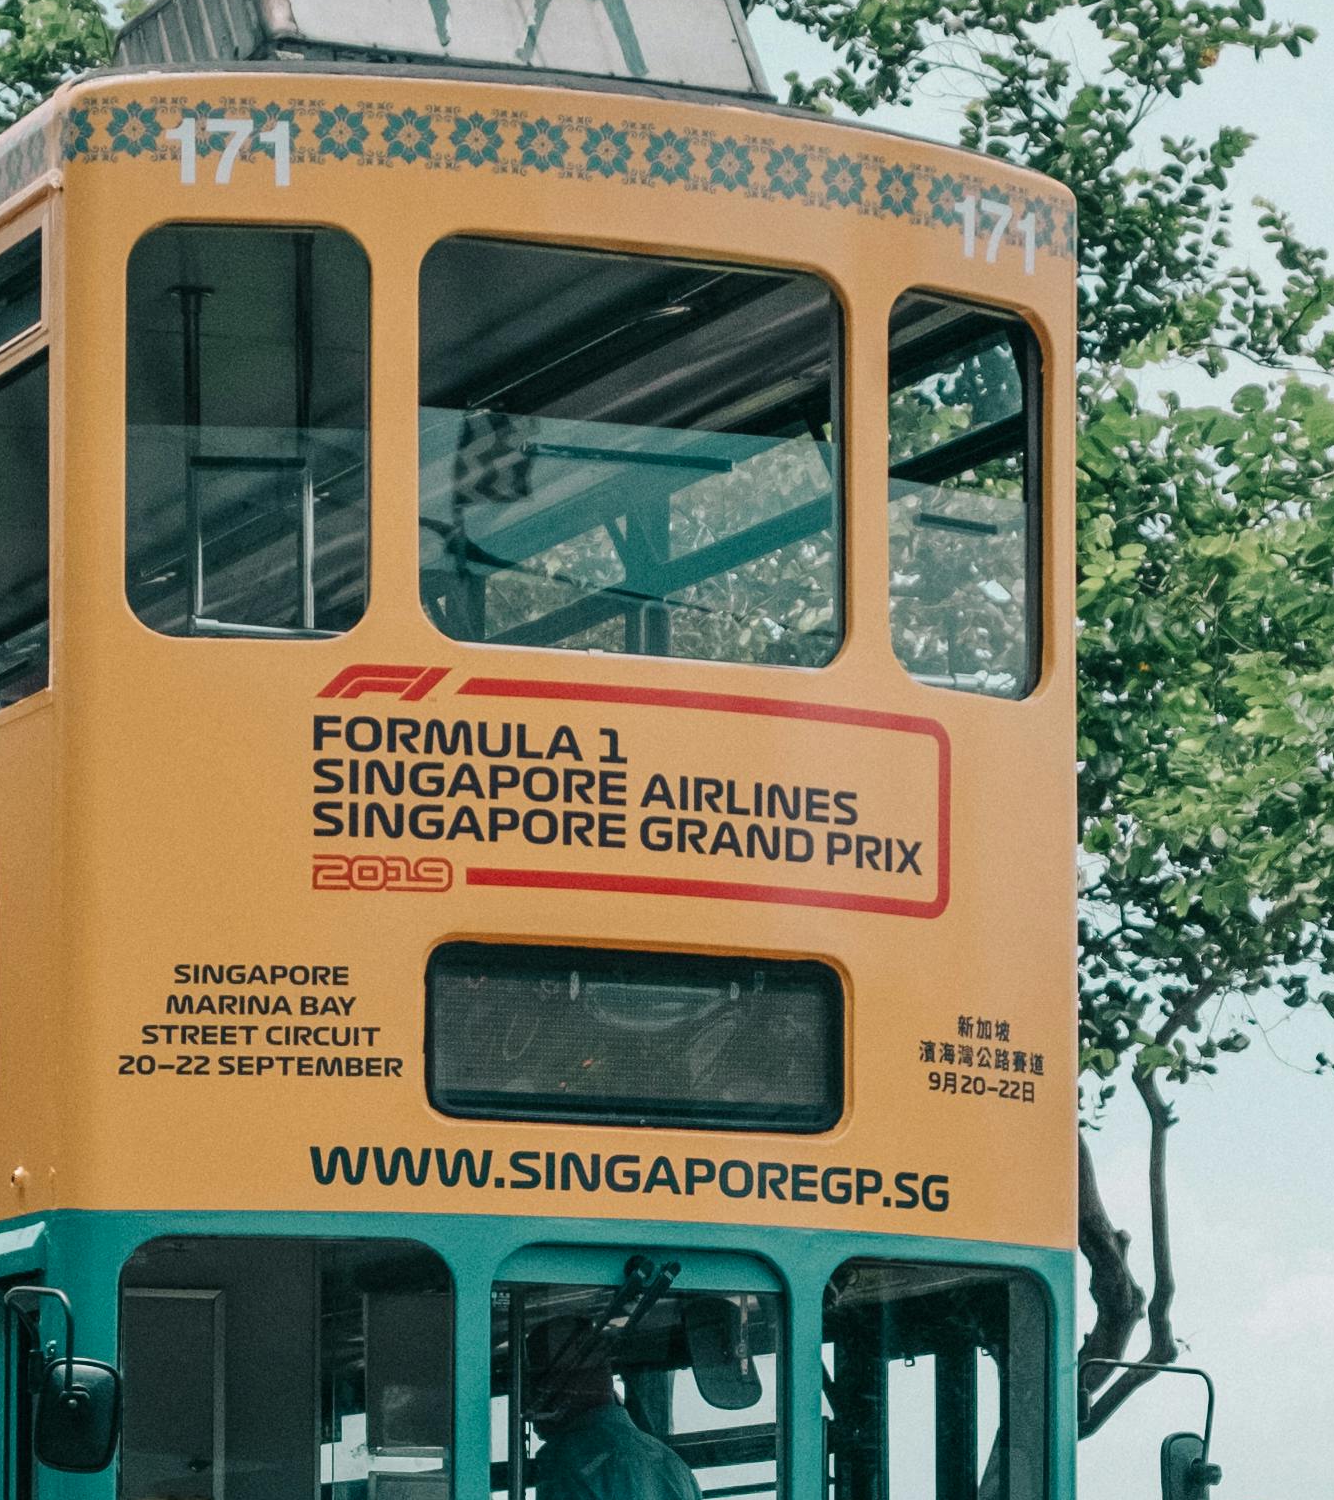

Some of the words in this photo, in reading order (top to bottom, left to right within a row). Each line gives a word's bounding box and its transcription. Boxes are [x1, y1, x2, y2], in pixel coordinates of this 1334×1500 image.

[166, 117, 291, 187] 171
[954, 194, 1036, 277] 171
[313, 714, 583, 762] FORMULA
[598, 728, 628, 764] 1
[312, 758, 627, 807] SINGAPORE
[639, 772, 859, 826] AIRLINES
[312, 801, 627, 849] SINGAPORE
[639, 816, 815, 863] GRAND
[826, 833, 924, 877] PRIX
[312, 853, 454, 892] 2019
[174, 964, 349, 986] SINGAPORE
[166, 994, 292, 1016] MARINA
[299, 996, 357, 1016] BAY
[141, 1024, 259, 1045] STREET
[265, 1026, 381, 1046] CIRCUIT
[957, 1014, 1011, 1043] 新加坡
[218, 1056, 404, 1077] SEPTEMBER
[919, 1040, 1045, 1076] 濱海灣公路賽道
[309, 1145, 950, 1212] WWW.SINGAPOREGP.SG
